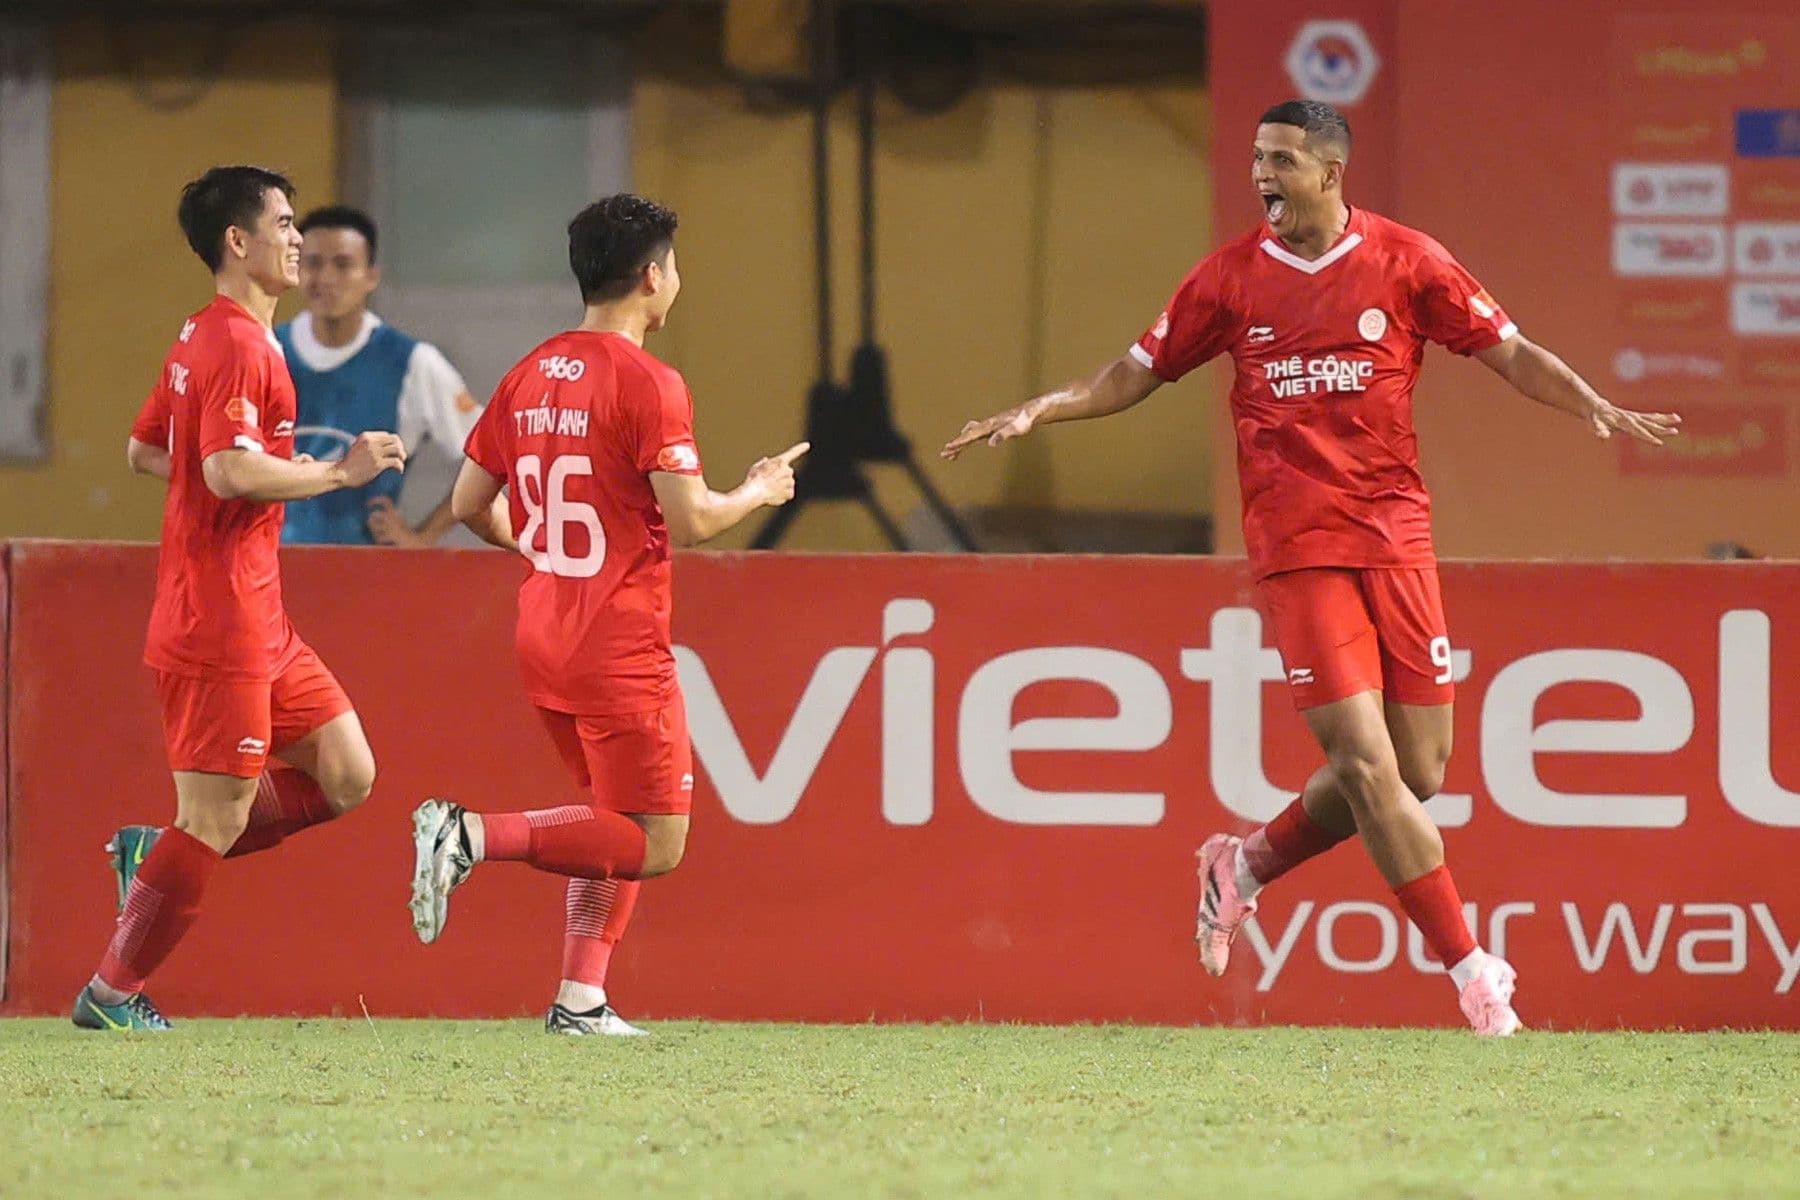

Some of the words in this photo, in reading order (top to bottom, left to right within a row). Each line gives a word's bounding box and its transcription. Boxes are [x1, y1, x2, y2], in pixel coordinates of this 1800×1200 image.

[1308, 354, 1373, 377] CÔNG
[1270, 376, 1366, 398] VIETTEL
[556, 408, 588, 438] ANH
[516, 454, 606, 578] 86
[1430, 636, 1452, 685] 9
